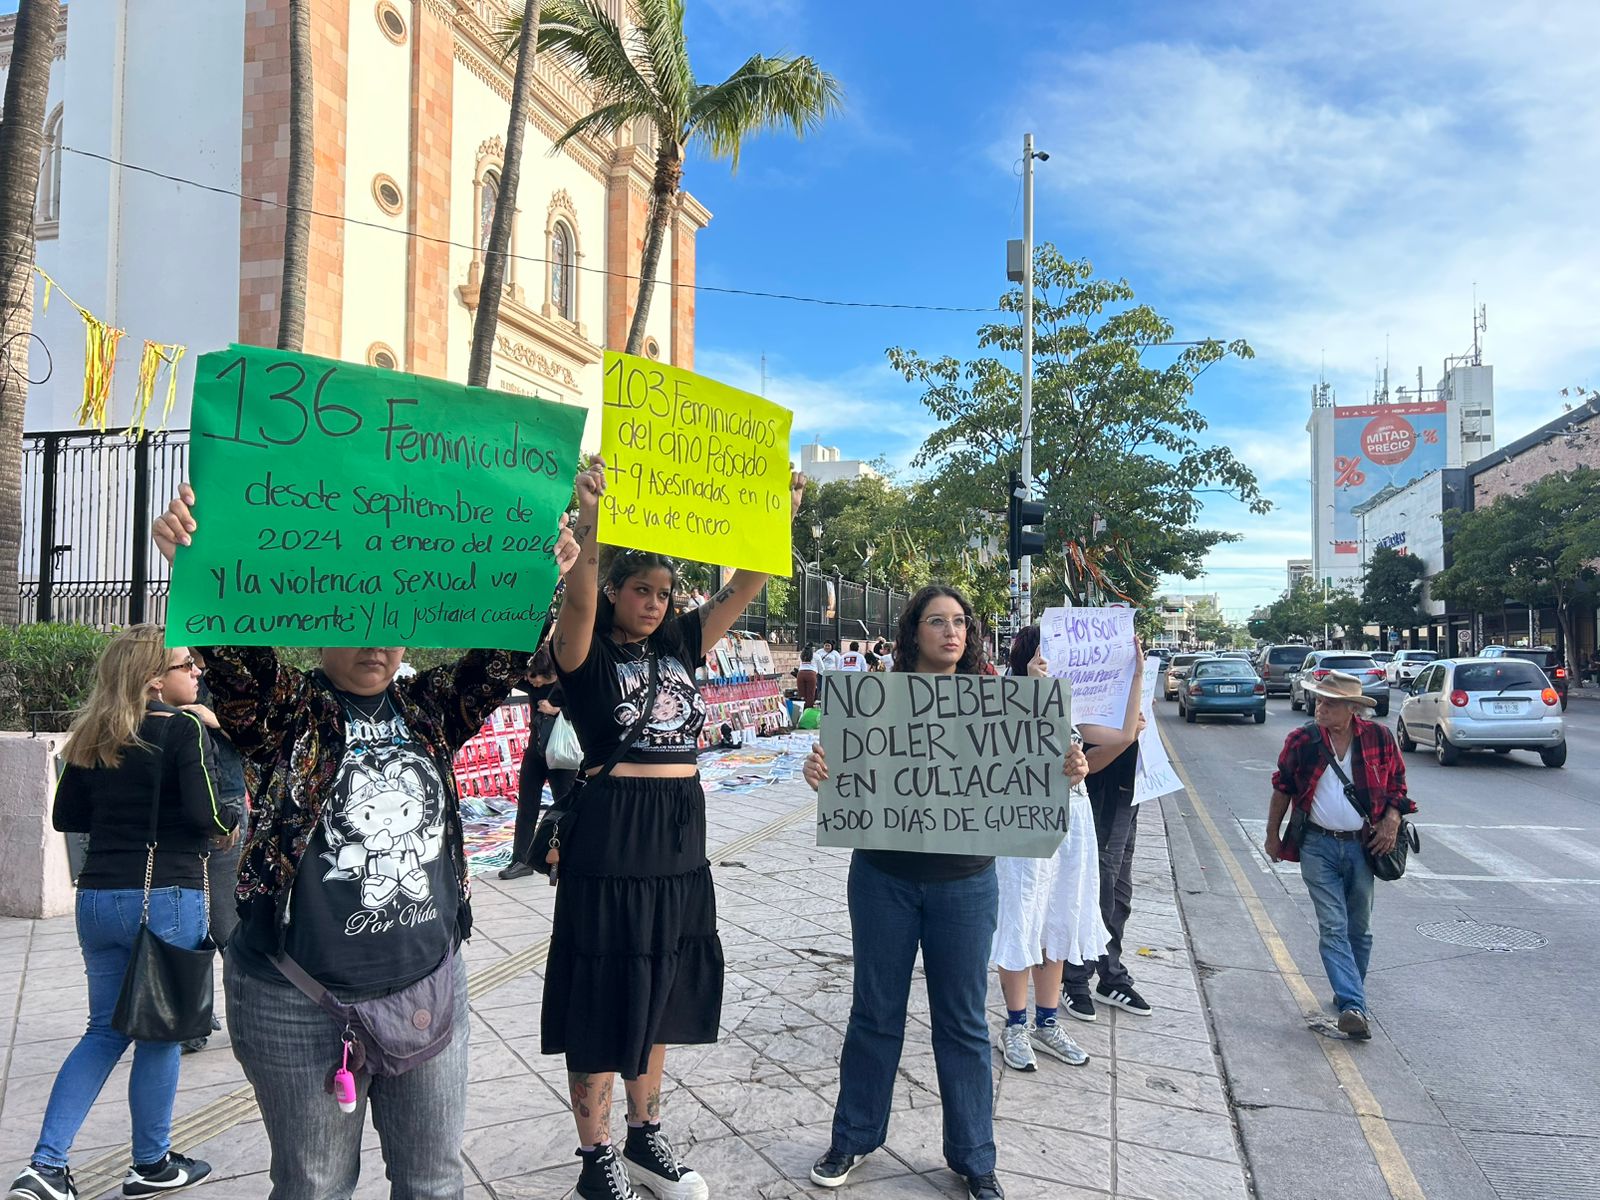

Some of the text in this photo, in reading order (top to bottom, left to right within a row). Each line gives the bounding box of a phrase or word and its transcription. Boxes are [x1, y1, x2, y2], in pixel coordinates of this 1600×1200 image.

[202, 355, 363, 448] 136
[604, 358, 670, 417] 103
[618, 417, 652, 451] del
[658, 428, 702, 464] año
[1367, 429, 1409, 444] MITAD
[1367, 440, 1410, 453] PRECIO
[244, 472, 341, 512] desde
[506, 497, 533, 524] de
[739, 487, 758, 504] en
[603, 495, 731, 535] que va de enero
[257, 528, 556, 554] 2024 a enero del 2026
[235, 559, 261, 594] la
[269, 566, 382, 595] violencia
[491, 571, 518, 588] va
[185, 613, 226, 634] en
[383, 602, 399, 629] la
[1065, 616, 1118, 644] HOY SON
[1068, 646, 1101, 667] ELLAS
[824, 675, 1065, 718] NO DEBERIA
[843, 719, 1062, 763] DOLER VIVIR
[836, 758, 1051, 798] EN CULIACÁN
[818, 805, 1068, 834] +500 DÍAS DE GUERRA
[344, 895, 438, 936] Por Vida
